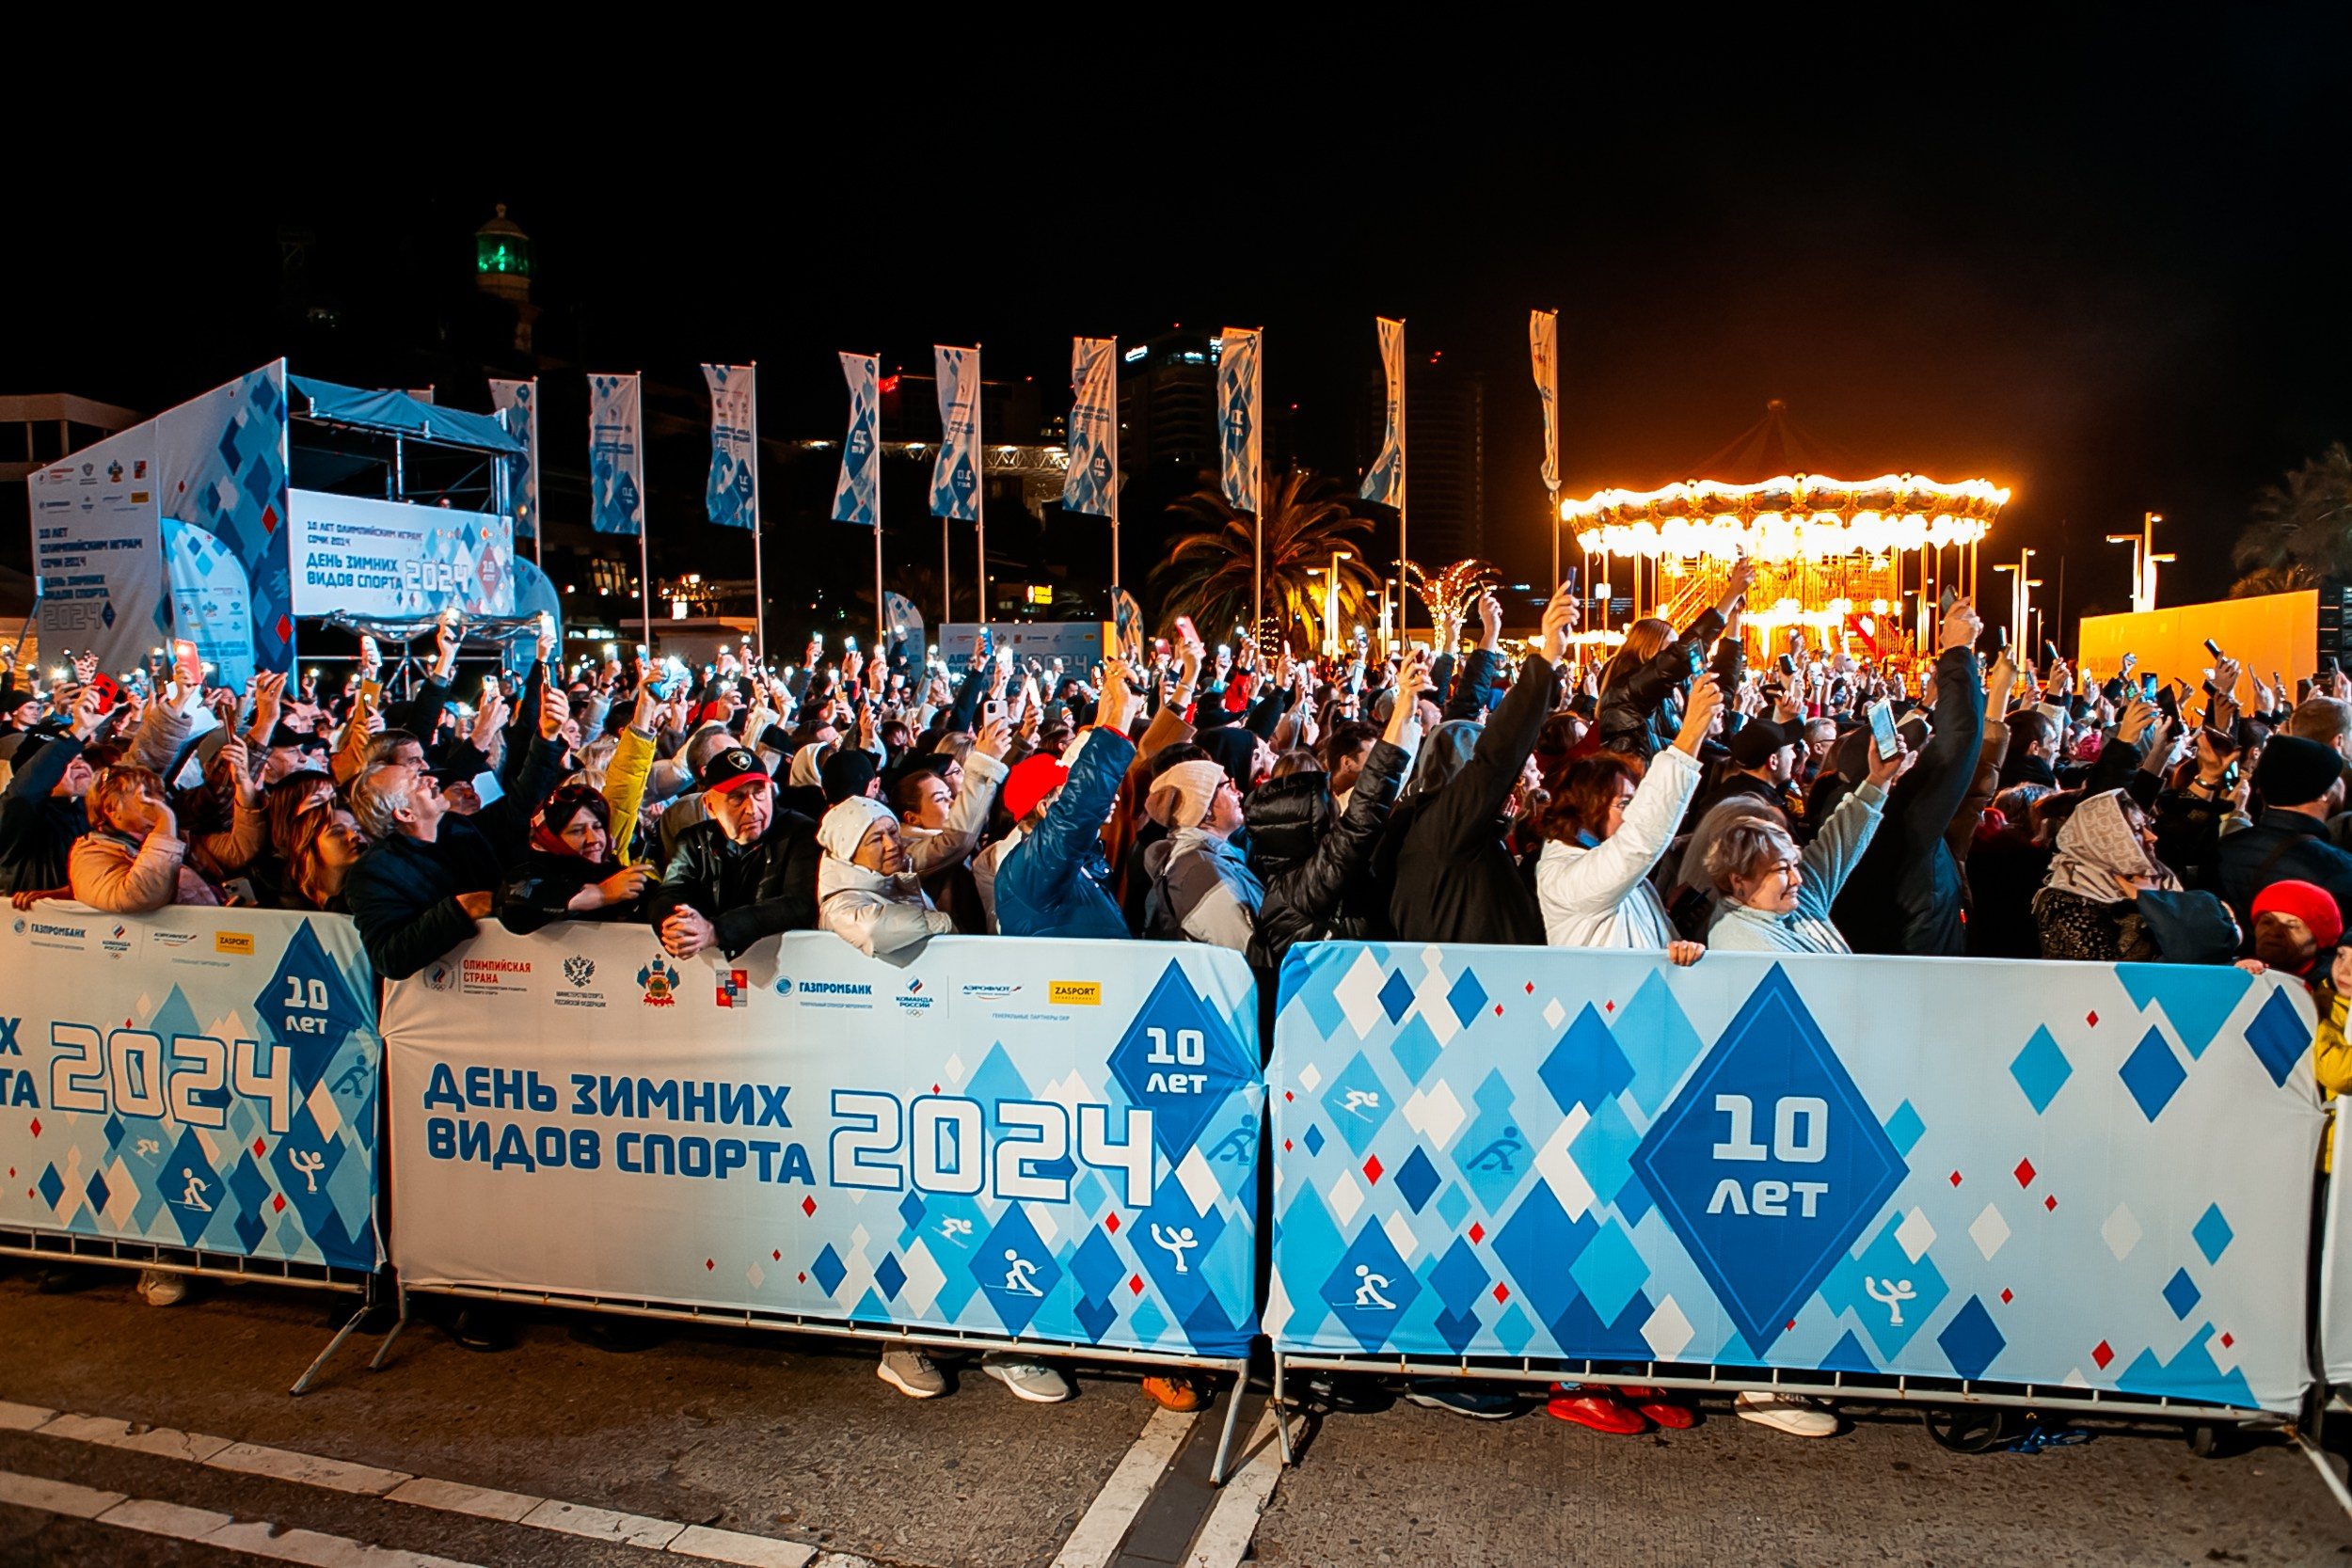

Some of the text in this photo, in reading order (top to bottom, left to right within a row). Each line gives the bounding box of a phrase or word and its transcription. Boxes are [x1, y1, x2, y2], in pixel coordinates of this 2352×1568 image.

[306, 551, 398, 572] ДЕНЬ ЗИМНИХ
[405, 558, 469, 594] 2024
[307, 570, 403, 590] ВИДОВ СПОРТА
[42, 602, 103, 632] 2024
[30, 923, 87, 939] ГАЗПРОМБАНК
[219, 936, 249, 946] ZASPORT
[463, 958, 532, 974] ОЛИМПИЙСКАЯ
[463, 972, 499, 984] СТРАНА
[284, 974, 329, 1011] 10
[799, 981, 873, 995] ГАЗПРОМБАНК
[1054, 987, 1096, 996] ZASPORT
[1147, 1027, 1205, 1066] 10
[50, 1021, 294, 1135] 2024
[423, 1062, 793, 1129] ДЕНЬ ЗИМНИХ
[1712, 1094, 1829, 1164] 10
[426, 1117, 817, 1186] ВИДОВ СПОРТА
[830, 1088, 1158, 1210] 2024
